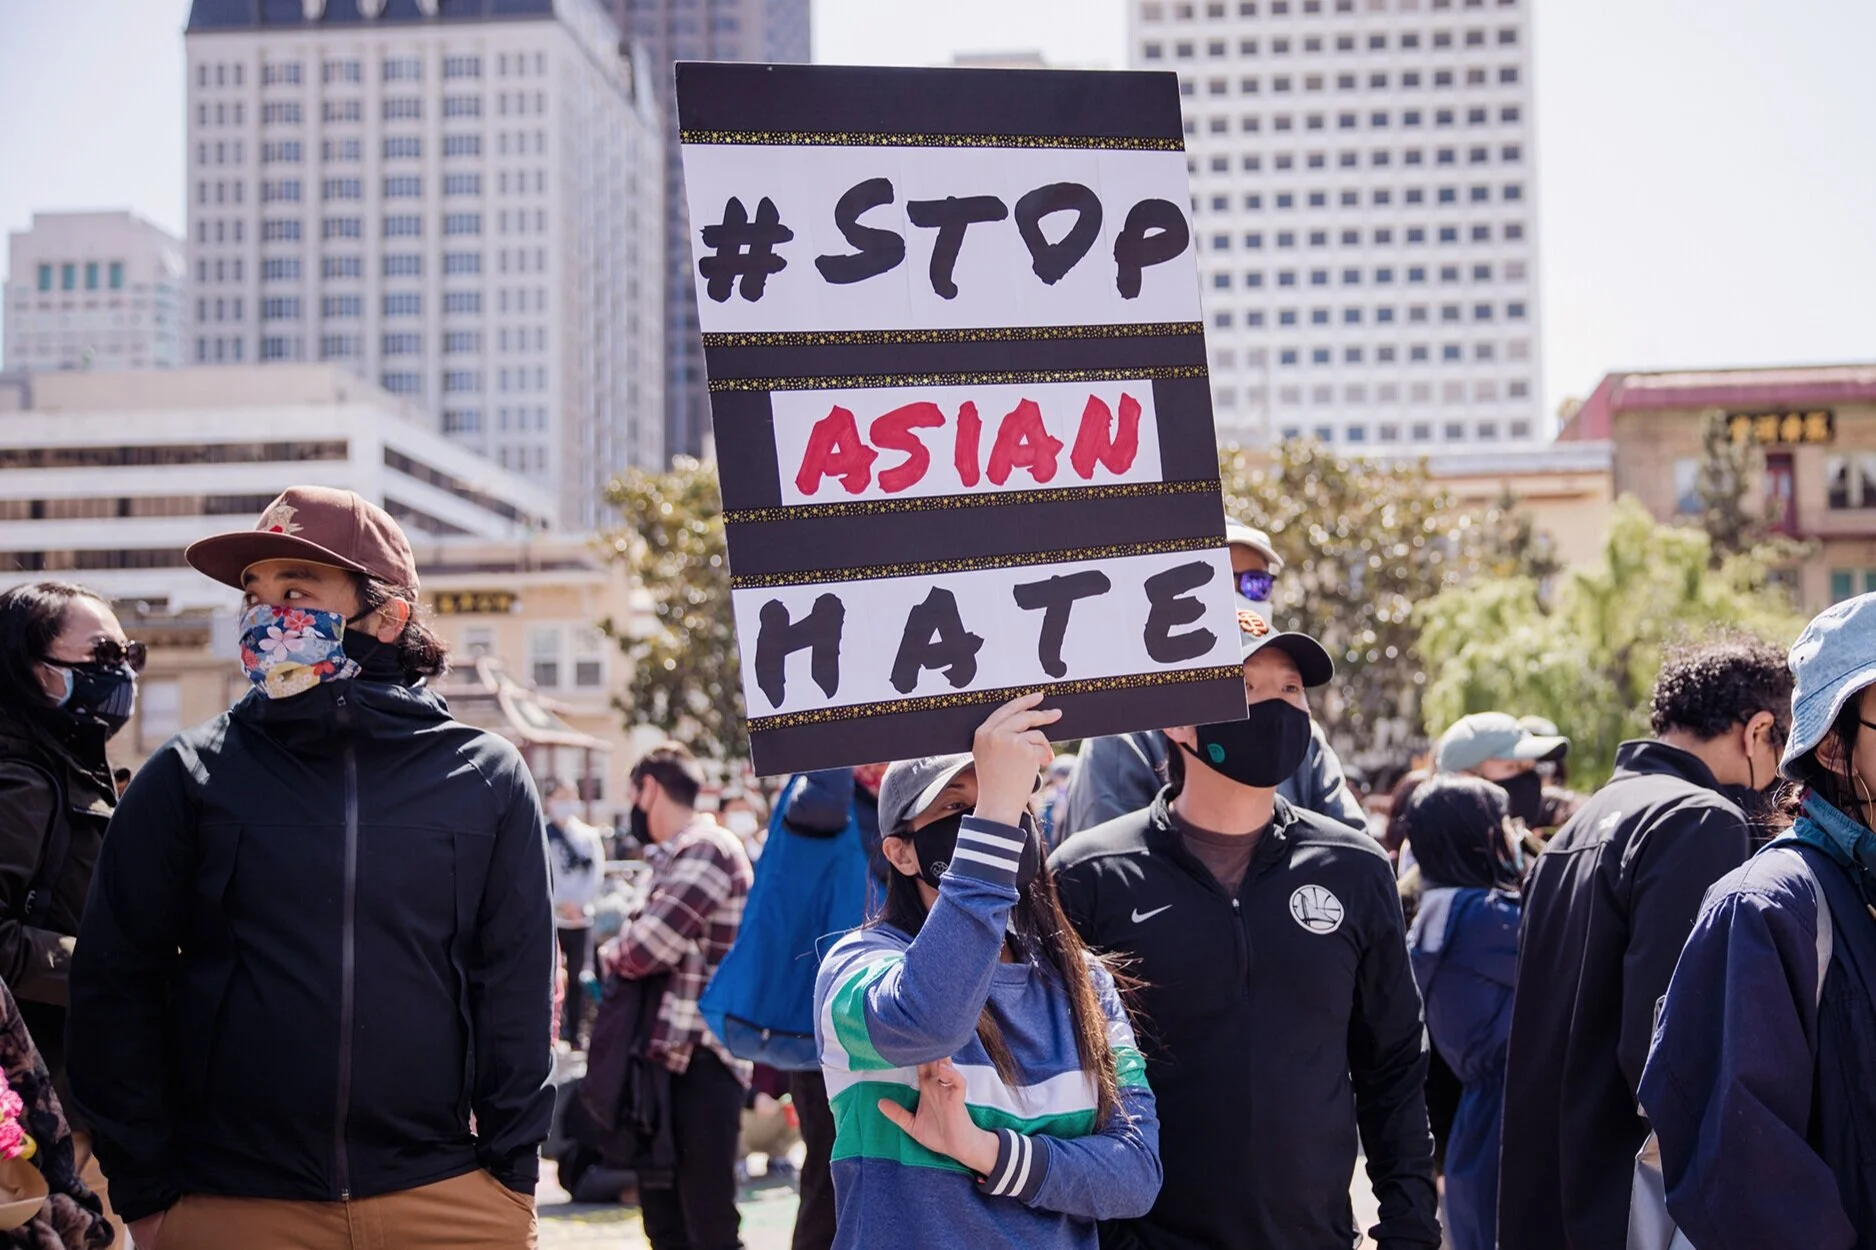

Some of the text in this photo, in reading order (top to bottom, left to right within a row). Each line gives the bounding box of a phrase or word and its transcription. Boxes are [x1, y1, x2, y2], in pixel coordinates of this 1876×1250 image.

[698, 177, 1190, 303] #STOP
[795, 392, 1142, 497] ASIAN
[754, 560, 1218, 709] HATE
